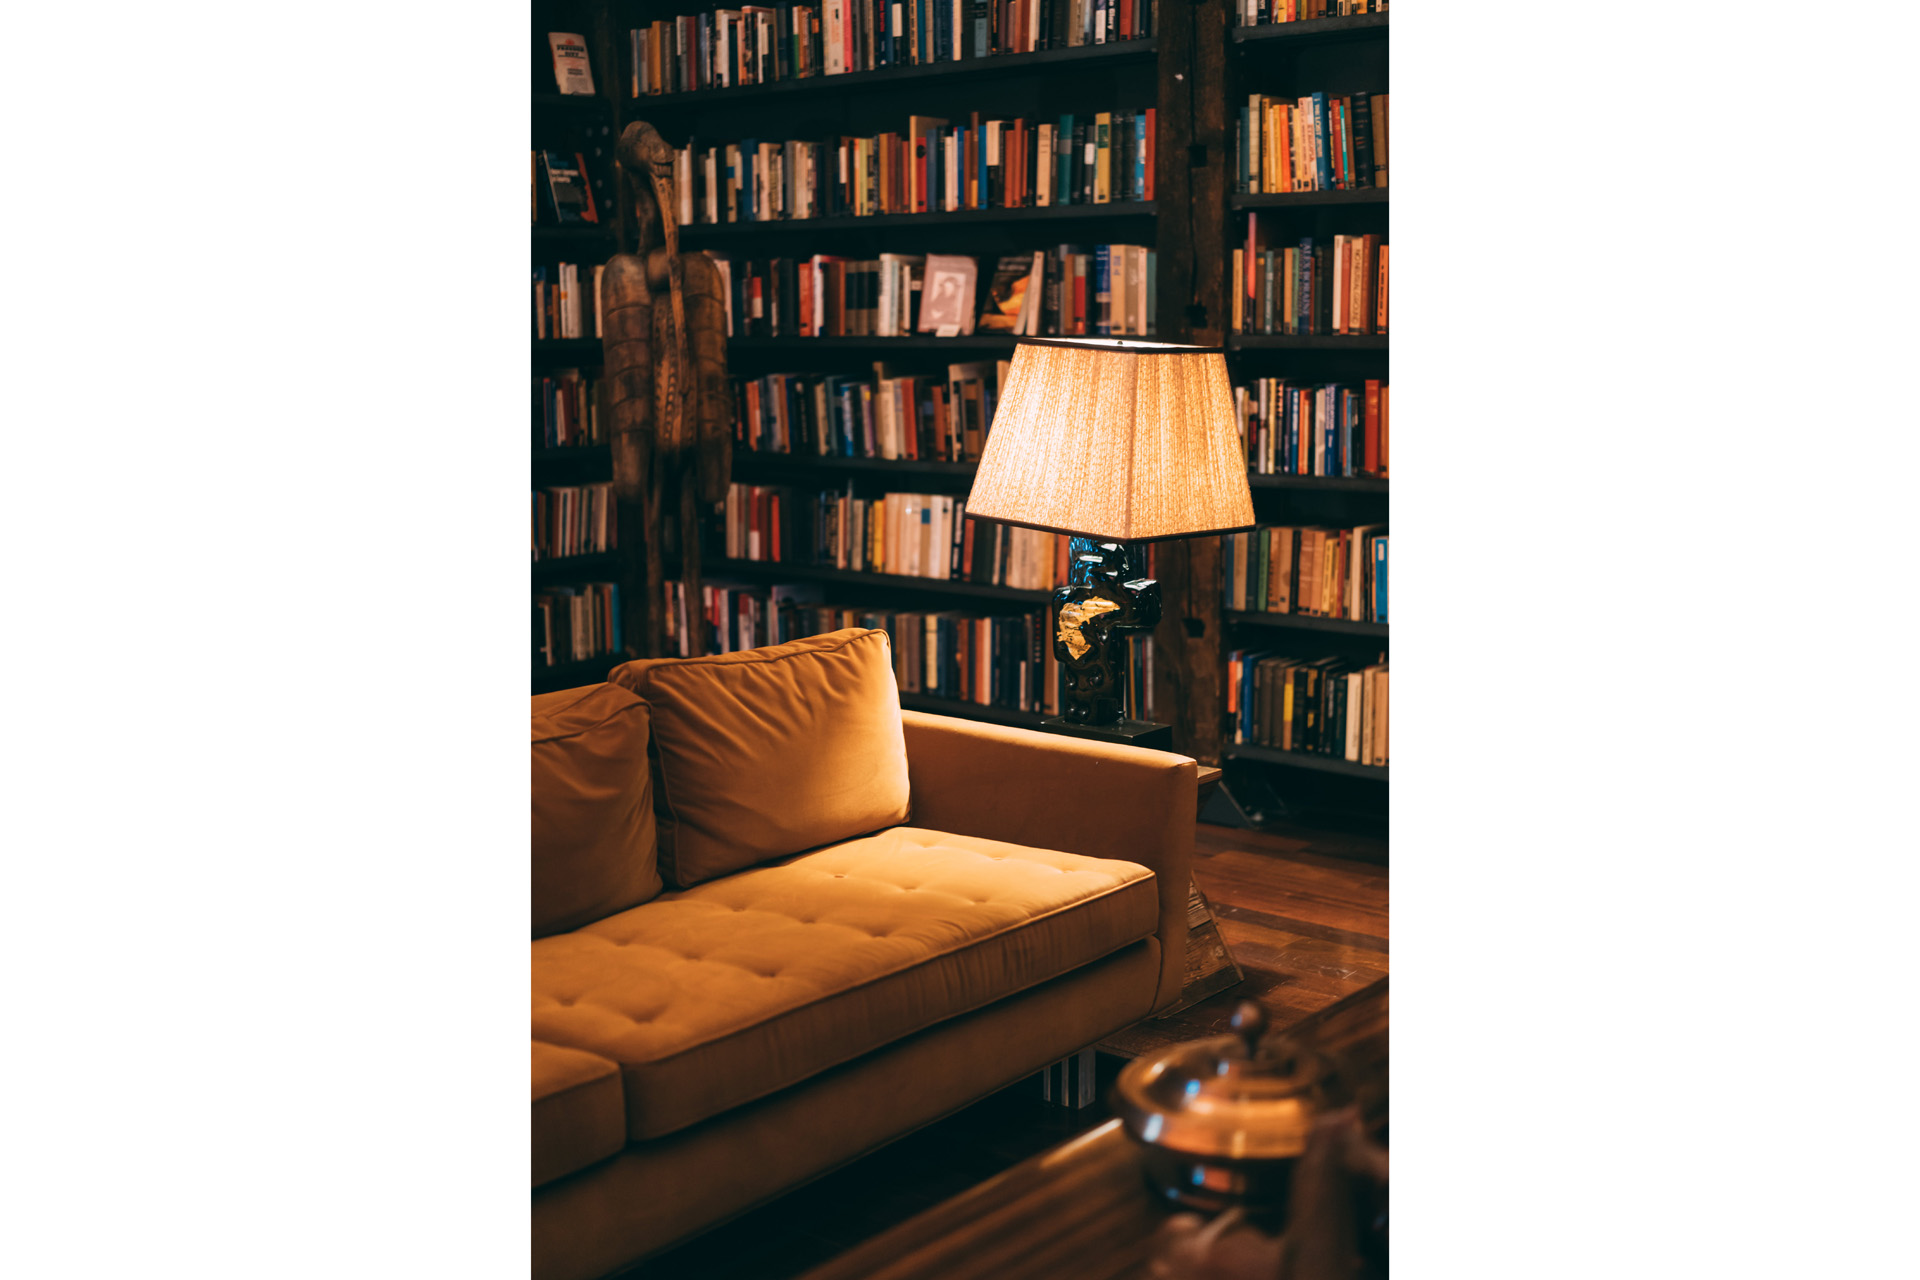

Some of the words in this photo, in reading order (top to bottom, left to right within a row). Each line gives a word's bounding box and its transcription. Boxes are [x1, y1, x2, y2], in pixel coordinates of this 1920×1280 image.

[1107, 8, 1116, 30] Glory
[1355, 249, 1361, 260] NO
[1352, 292, 1360, 324] GROUND
